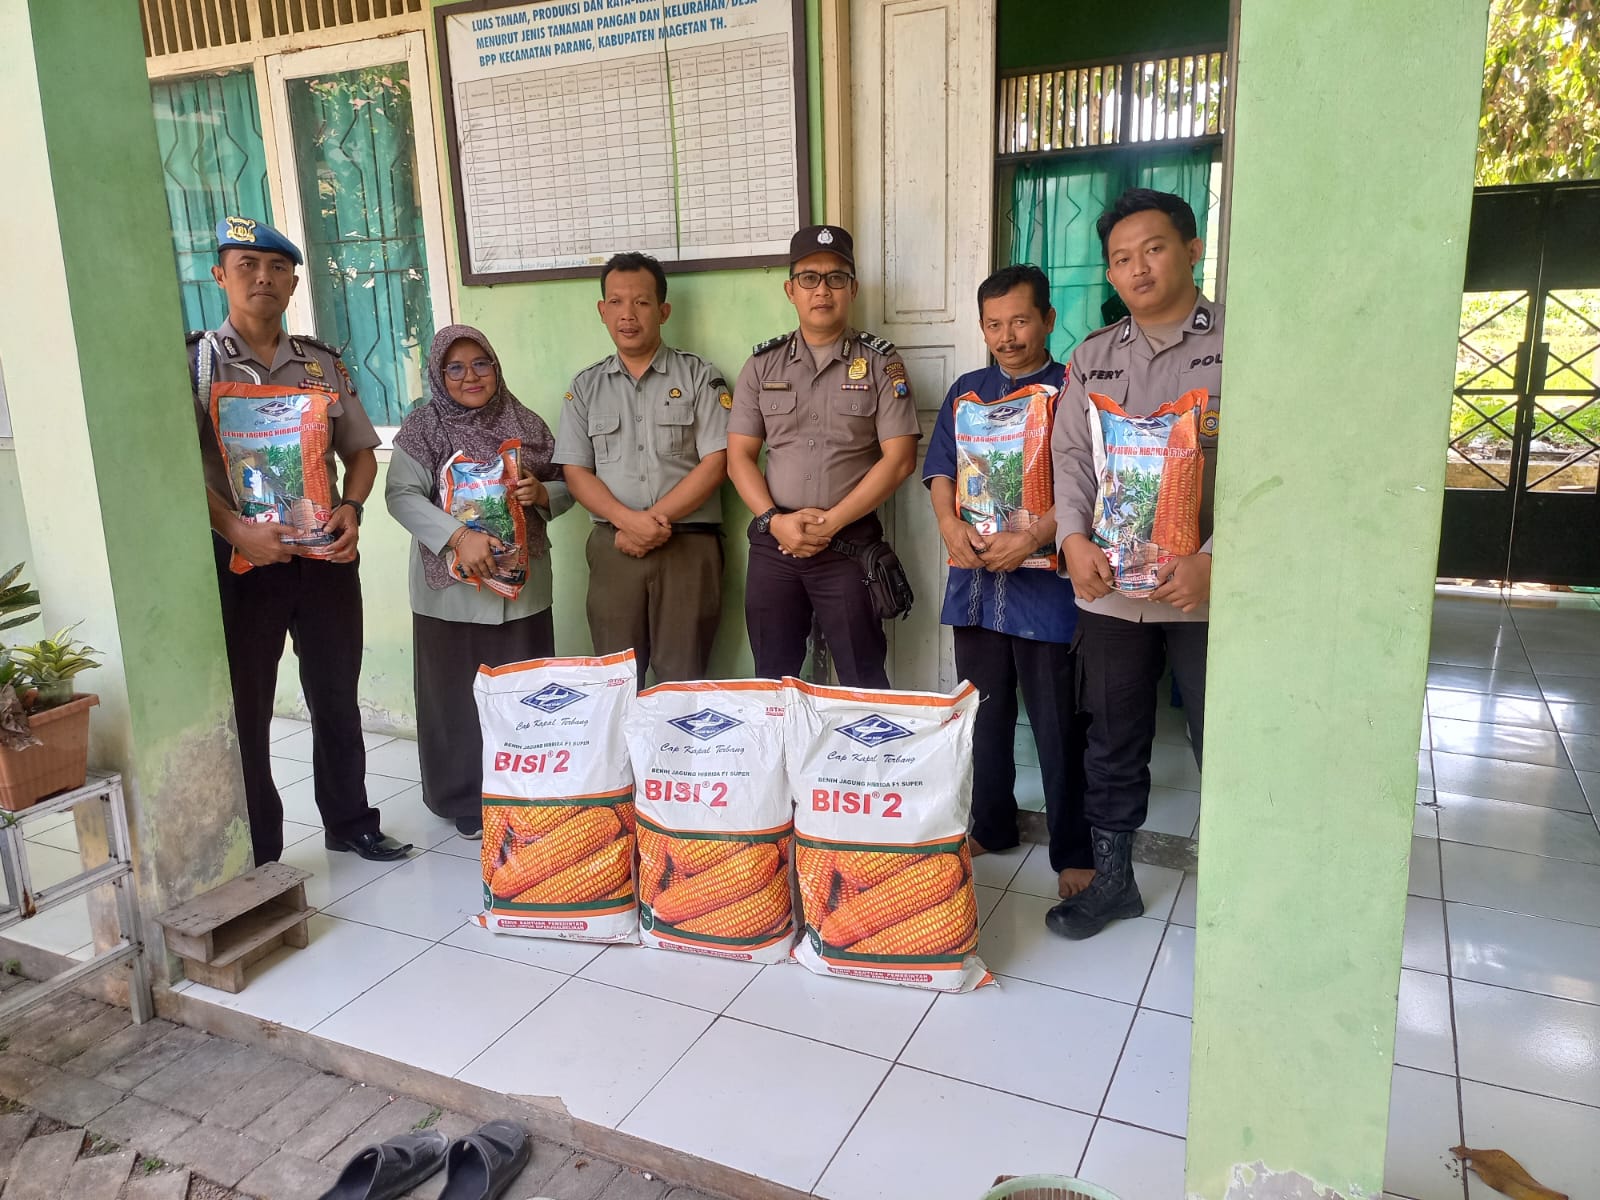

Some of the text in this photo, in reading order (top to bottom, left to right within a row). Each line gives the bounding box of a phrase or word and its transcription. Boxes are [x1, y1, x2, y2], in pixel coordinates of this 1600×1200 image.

[472, 17, 494, 32] LUAS
[495, 11, 530, 27] TANAM,
[533, 3, 580, 21] PRODUKSI
[583, 0, 604, 13] DAN
[476, 31, 518, 49] MENURUT
[521, 27, 546, 42] JENIS
[548, 19, 594, 36] TANAMAN
[597, 12, 637, 29] PANGAN
[640, 8, 660, 22] DAN
[479, 54, 497, 67] BPP
[500, 45, 552, 64] KECAMATAN
[554, 39, 596, 55] PARANG,
[598, 28, 655, 48] KABUPATEN
[658, 20, 707, 39] MAGETAN
[710, 16, 727, 31] TH.
[1089, 369, 1124, 380] FERY
[982, 523, 991, 534] 2
[660, 743, 679, 754] Cap
[827, 750, 916, 764] Cap Kapal Terbang
[553, 749, 571, 773] 2
[839, 778, 866, 786] JAGUNG
[710, 782, 728, 807] 2
[882, 792, 902, 818] 2
